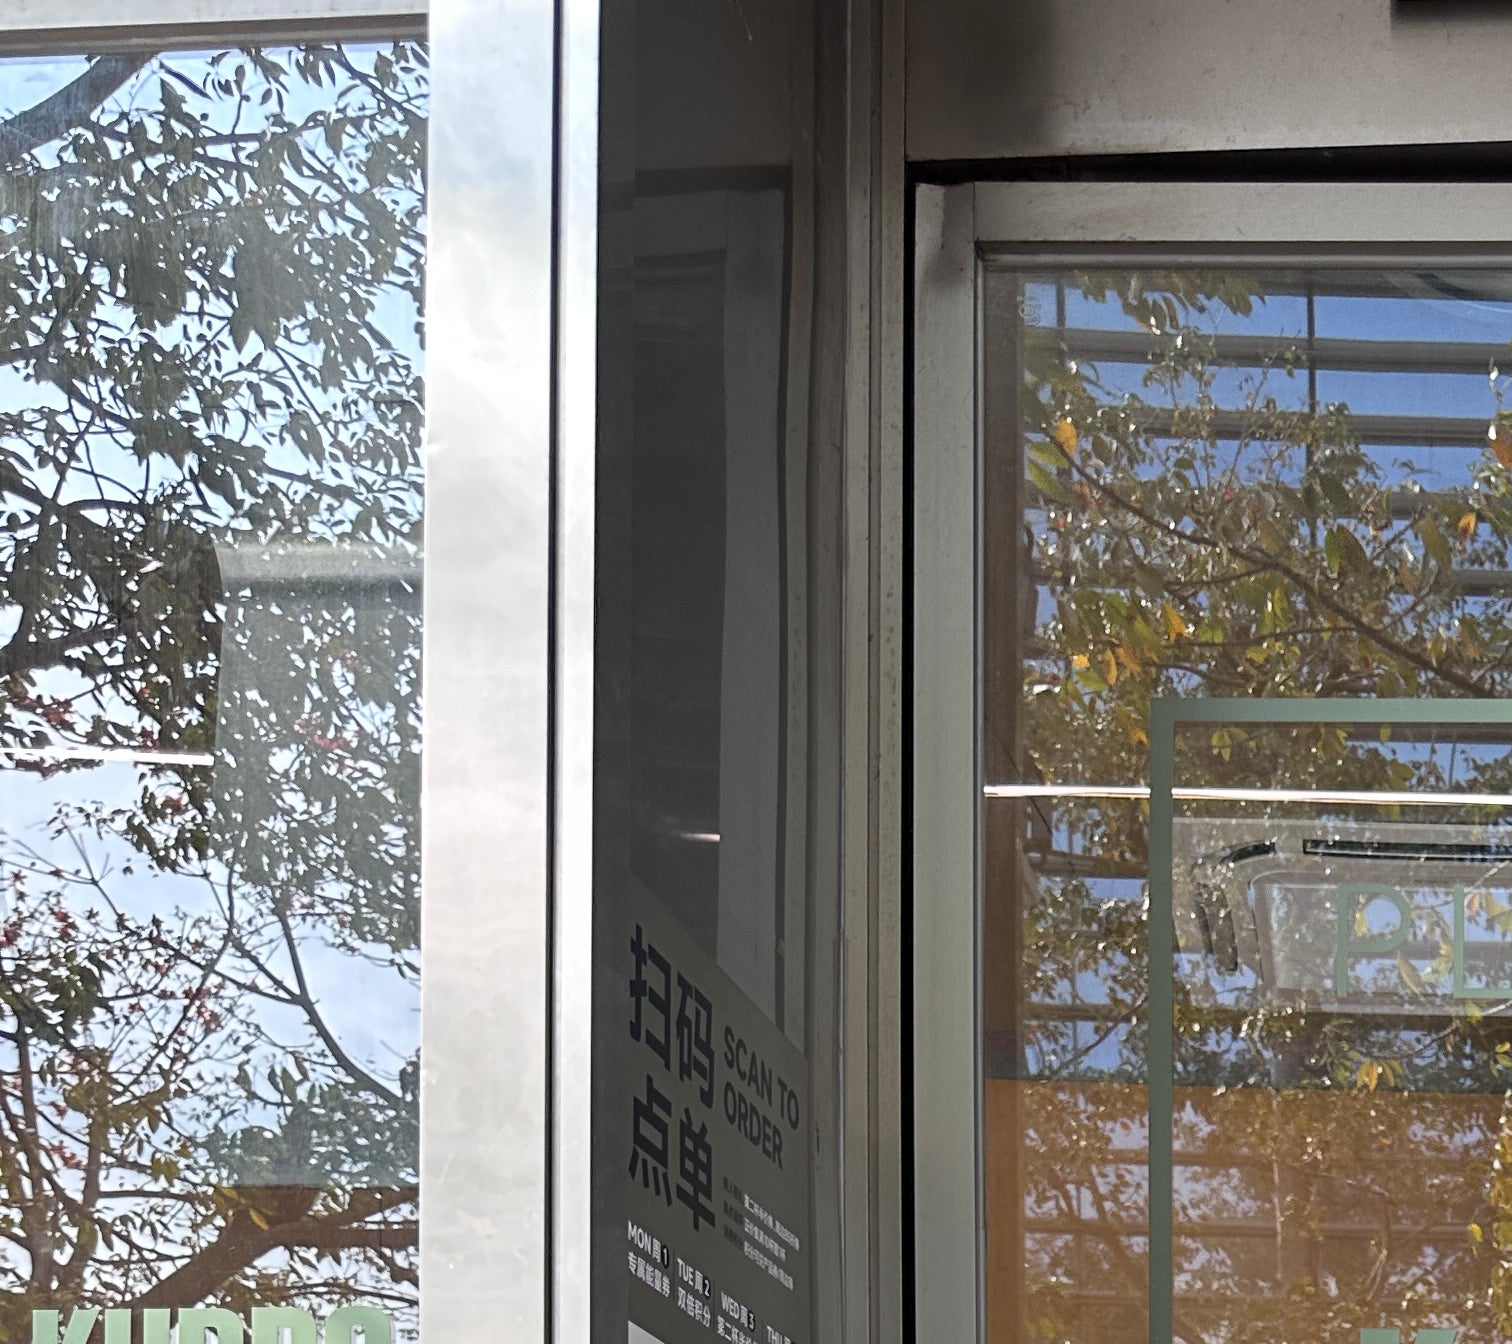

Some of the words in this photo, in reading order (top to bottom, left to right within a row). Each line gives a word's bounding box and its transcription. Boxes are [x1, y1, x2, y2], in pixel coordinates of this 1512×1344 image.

[628, 922, 716, 1109] 扫码
[724, 1025, 773, 1108] SCAN
[777, 1076, 800, 1130] TO
[628, 1073, 716, 1231] 点单
[724, 1081, 783, 1169] ORDER
[627, 1219, 652, 1254] MON
[677, 1257, 695, 1287] TUE
[720, 1291, 740, 1321] WED
